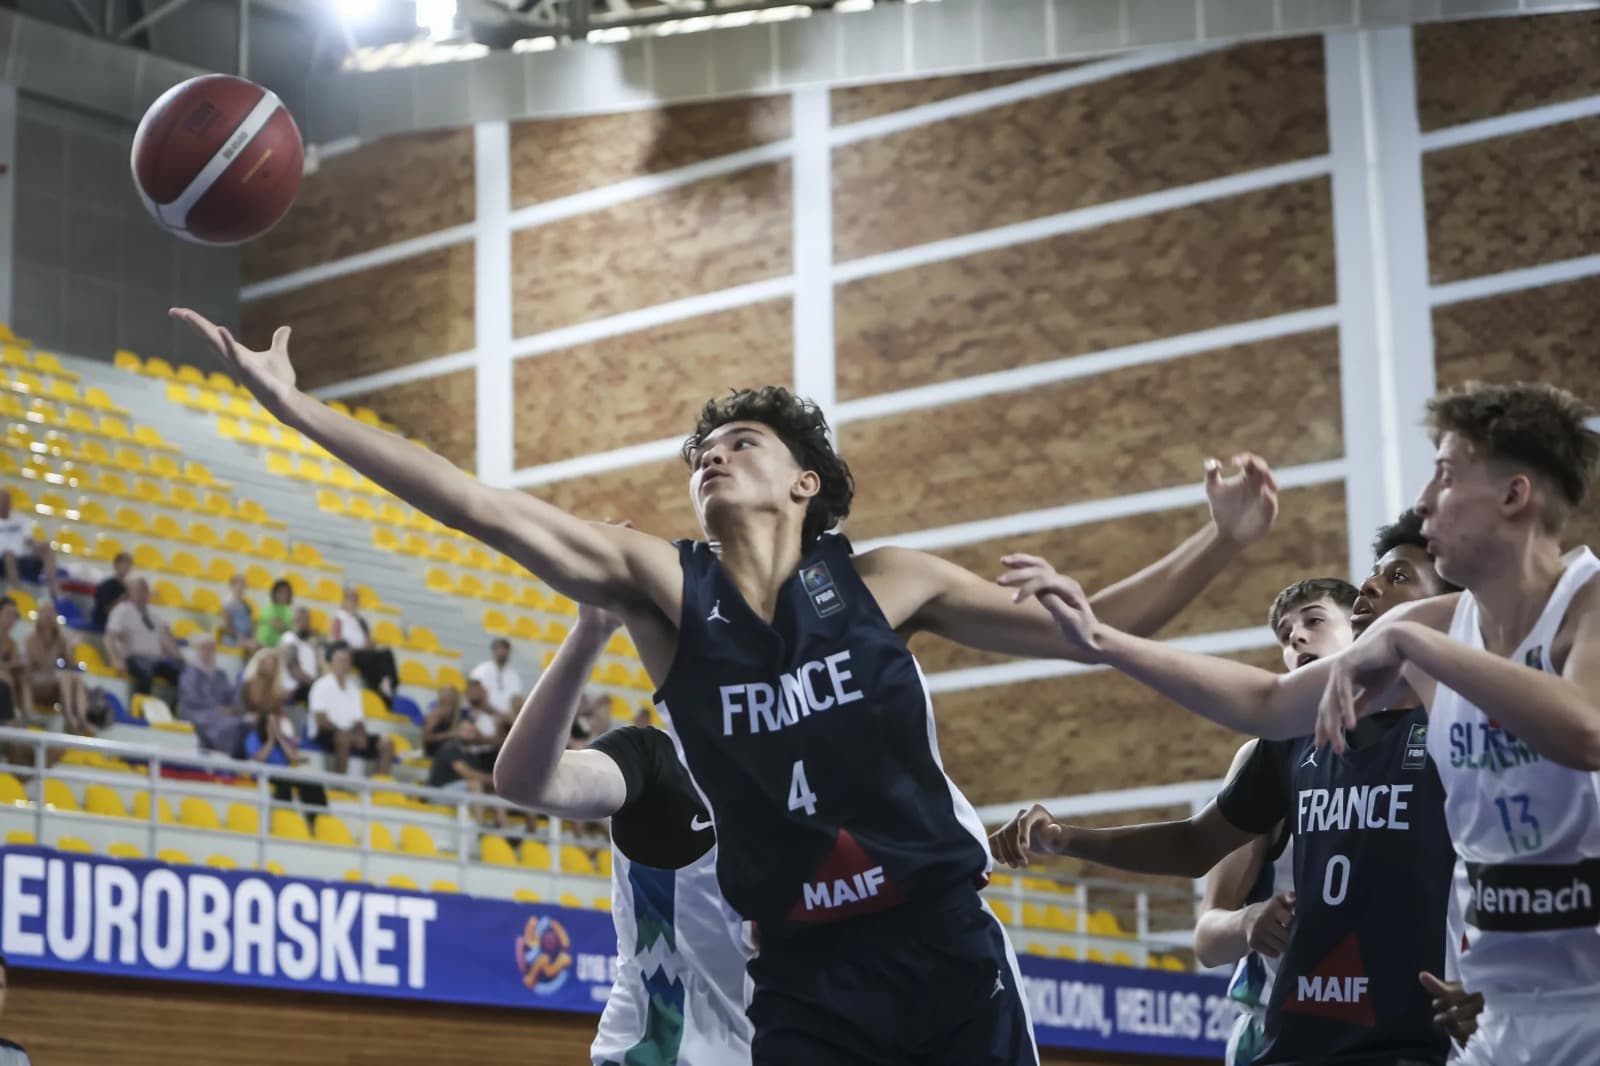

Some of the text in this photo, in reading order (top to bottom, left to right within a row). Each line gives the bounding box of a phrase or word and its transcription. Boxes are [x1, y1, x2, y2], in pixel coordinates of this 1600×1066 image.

[719, 650, 863, 736] FRANCE
[787, 759, 817, 816] 4
[1297, 783, 1413, 834] FRANCE
[1495, 794, 1542, 854] 13
[803, 866, 885, 911] MAIF
[1322, 854, 1350, 906] 0
[1470, 878, 1592, 915] lemach
[2, 853, 437, 989] EUROBASKET
[1114, 986, 1202, 1039] HELLAS
[1298, 975, 1369, 1003] MAIF
